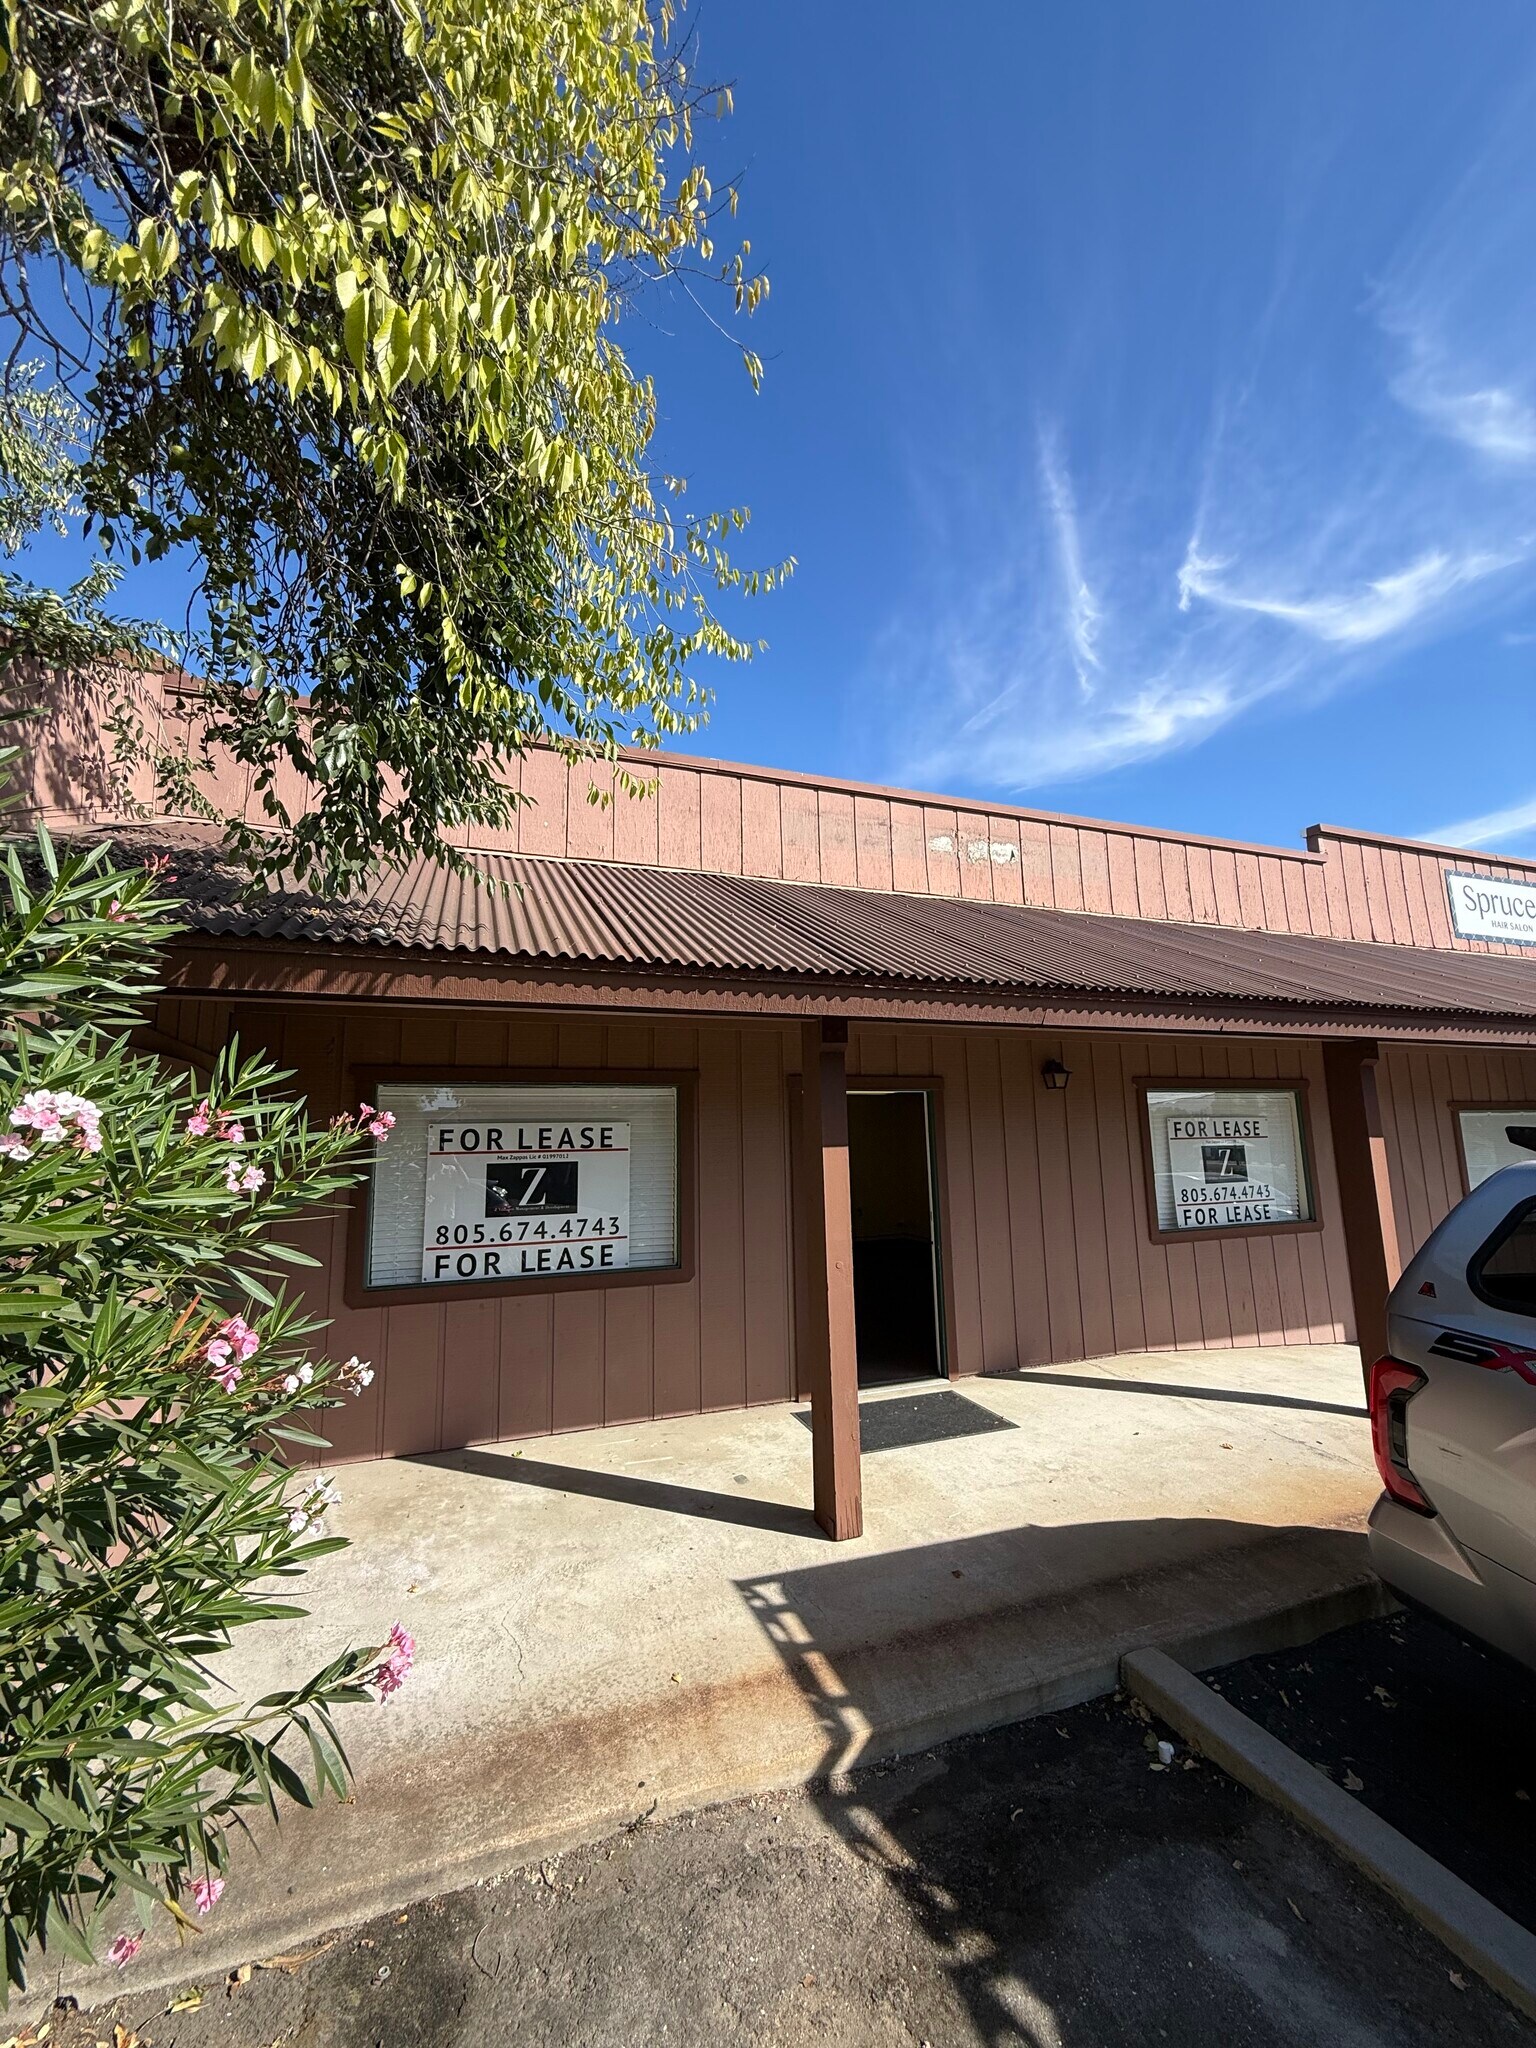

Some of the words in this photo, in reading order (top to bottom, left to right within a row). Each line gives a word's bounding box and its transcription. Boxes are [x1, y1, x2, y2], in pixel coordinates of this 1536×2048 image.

[1463, 885, 1536, 920] Spruce
[1491, 920, 1508, 930] HAIR
[1510, 923, 1533, 933] SALON
[439, 1128, 504, 1152] FOR
[518, 1127, 613, 1150] LEASE
[1173, 1121, 1208, 1137] FOR
[1213, 1121, 1261, 1136] LEASE
[1218, 1149, 1233, 1176] Z
[519, 1167, 547, 1206] Z
[1181, 1185, 1271, 1203] 805.674.4743
[1183, 1208, 1218, 1225] FOR
[1226, 1204, 1272, 1222] LEASE
[436, 1217, 620, 1245] 805.674.4743
[434, 1252, 501, 1279] FOR
[521, 1244, 614, 1273] LEASE
